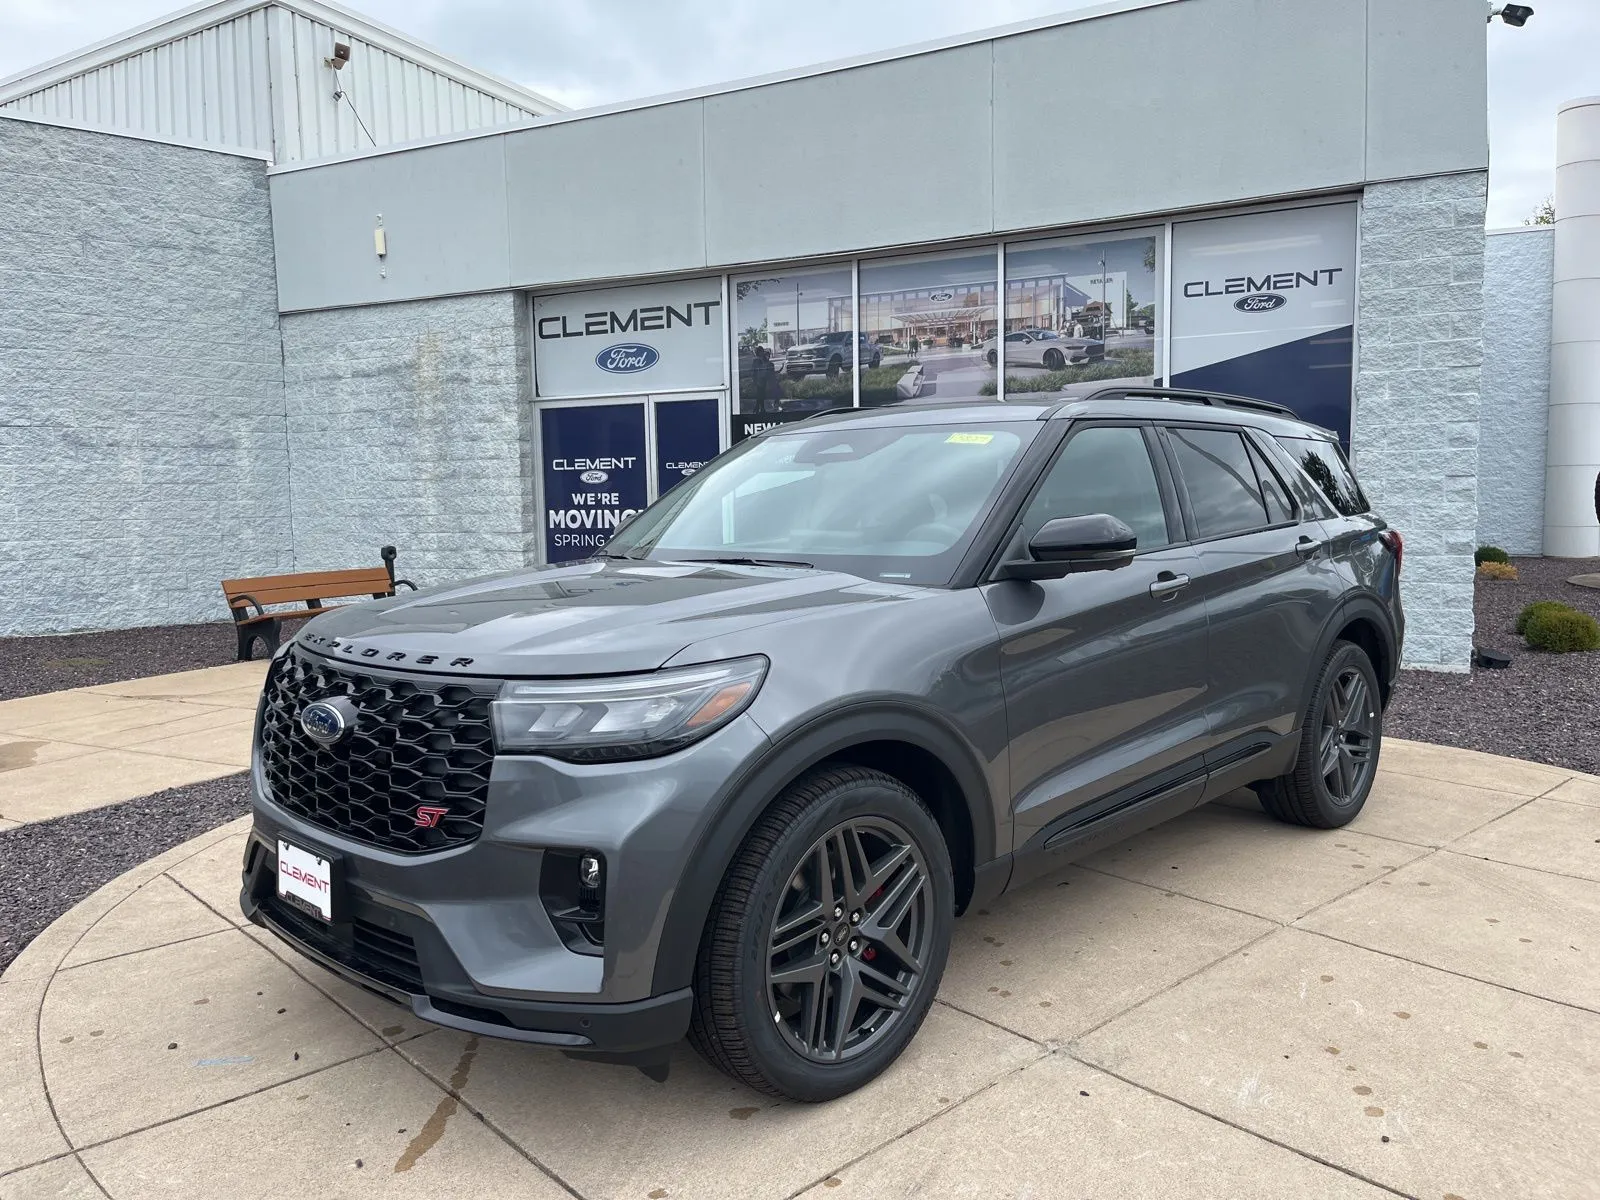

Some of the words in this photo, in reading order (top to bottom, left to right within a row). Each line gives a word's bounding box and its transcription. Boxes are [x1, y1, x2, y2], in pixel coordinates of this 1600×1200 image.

[1184, 267, 1343, 298] CLEMENT
[1243, 296, 1277, 310] Ford
[538, 301, 721, 340] CLEMENT
[606, 347, 647, 369] Ford
[744, 422, 776, 435] NEW
[552, 457, 637, 471] CLEMENT
[585, 472, 603, 482] Ford
[571, 492, 620, 505] WE'RE
[549, 509, 645, 529] MOVIN
[554, 534, 605, 547] SPRING
[414, 806, 449, 828] ST
[280, 860, 330, 894] CLEMENT
